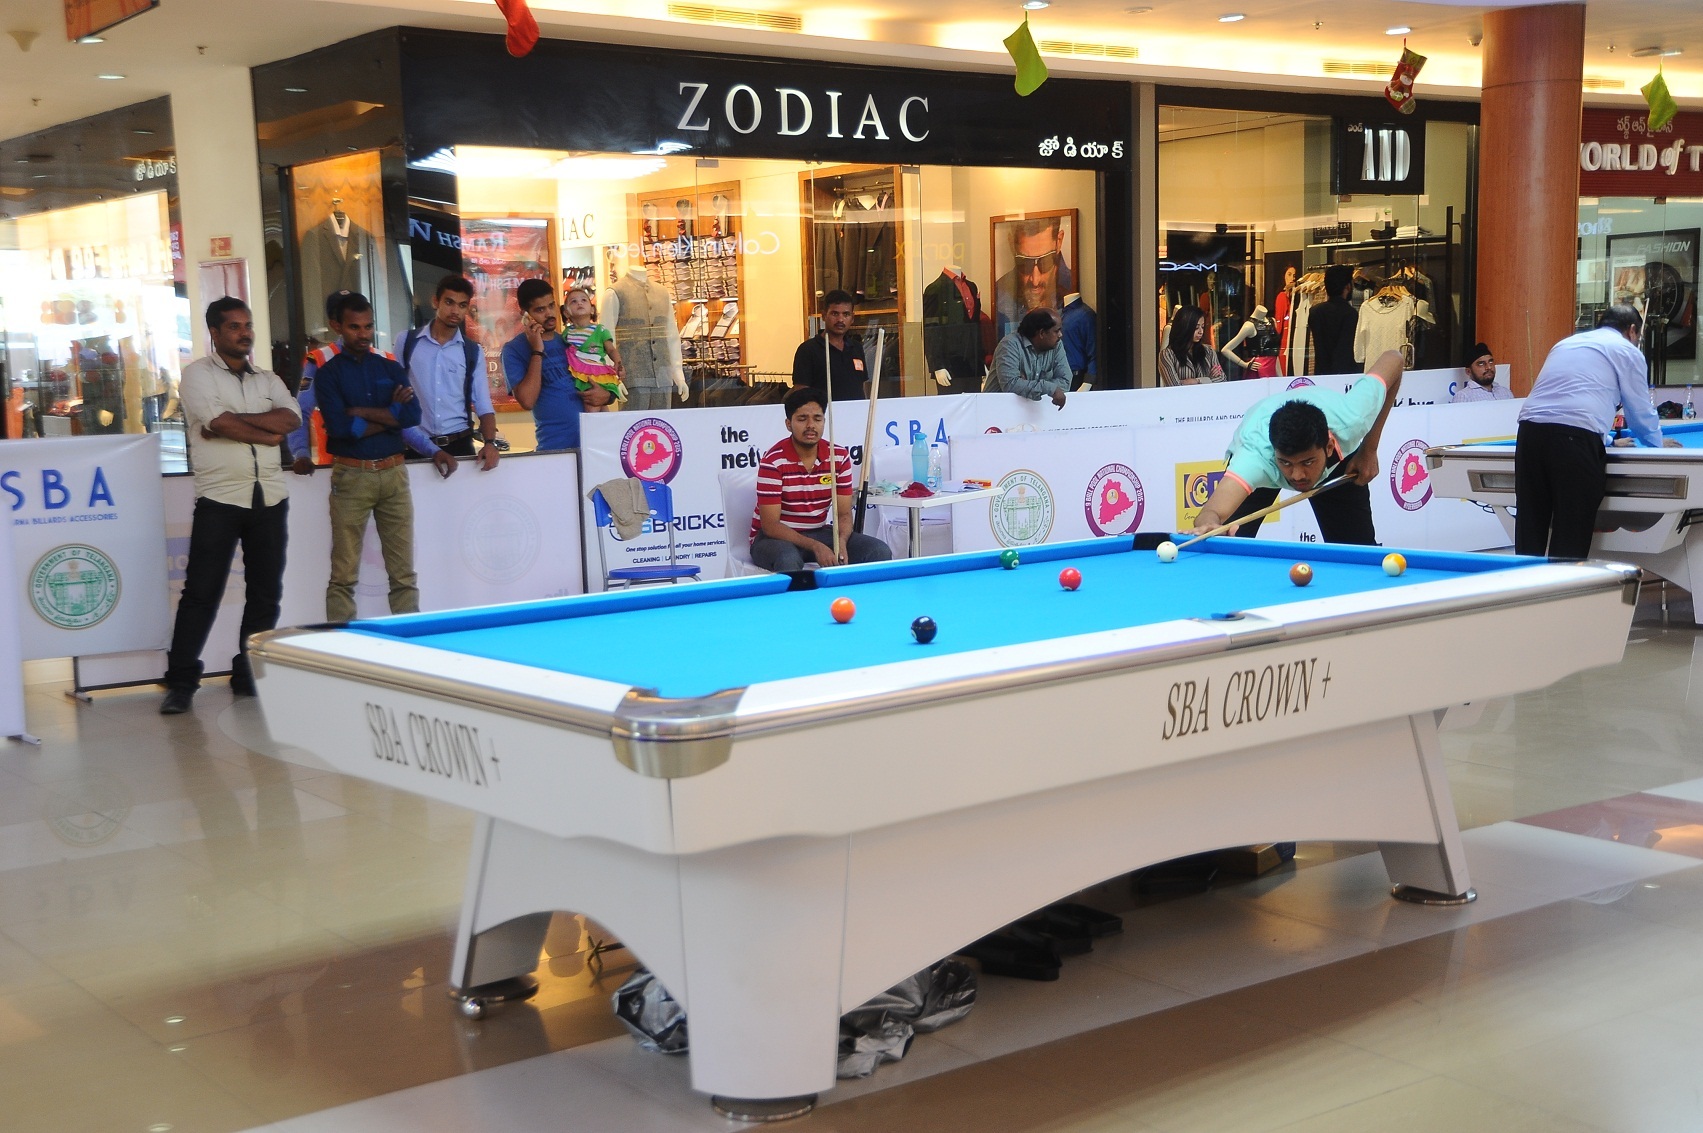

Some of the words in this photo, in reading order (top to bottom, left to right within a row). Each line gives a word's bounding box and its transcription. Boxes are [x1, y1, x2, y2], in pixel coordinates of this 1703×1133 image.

[677, 82, 930, 142] ZODIAC
[1361, 129, 1411, 181] AND
[1580, 141, 1658, 172] ORLD
[1660, 138, 1685, 176] of
[562, 213, 595, 241] IAC
[1637, 241, 1691, 254] FASHION
[721, 426, 749, 443] the
[0, 466, 116, 511] SBA
[70, 513, 119, 522] ACCESSORIES
[682, 542, 693, 550] your
[1299, 532, 1316, 543] the
[35, 551, 67, 588] GOVERNMENT
[86, 551, 115, 583] TELANGANA
[632, 556, 660, 564] CLEANING
[665, 553, 690, 561] LANDRY
[694, 551, 717, 559] REPAIRS
[1161, 677, 1210, 741] SBA
[365, 701, 409, 767] SBA
